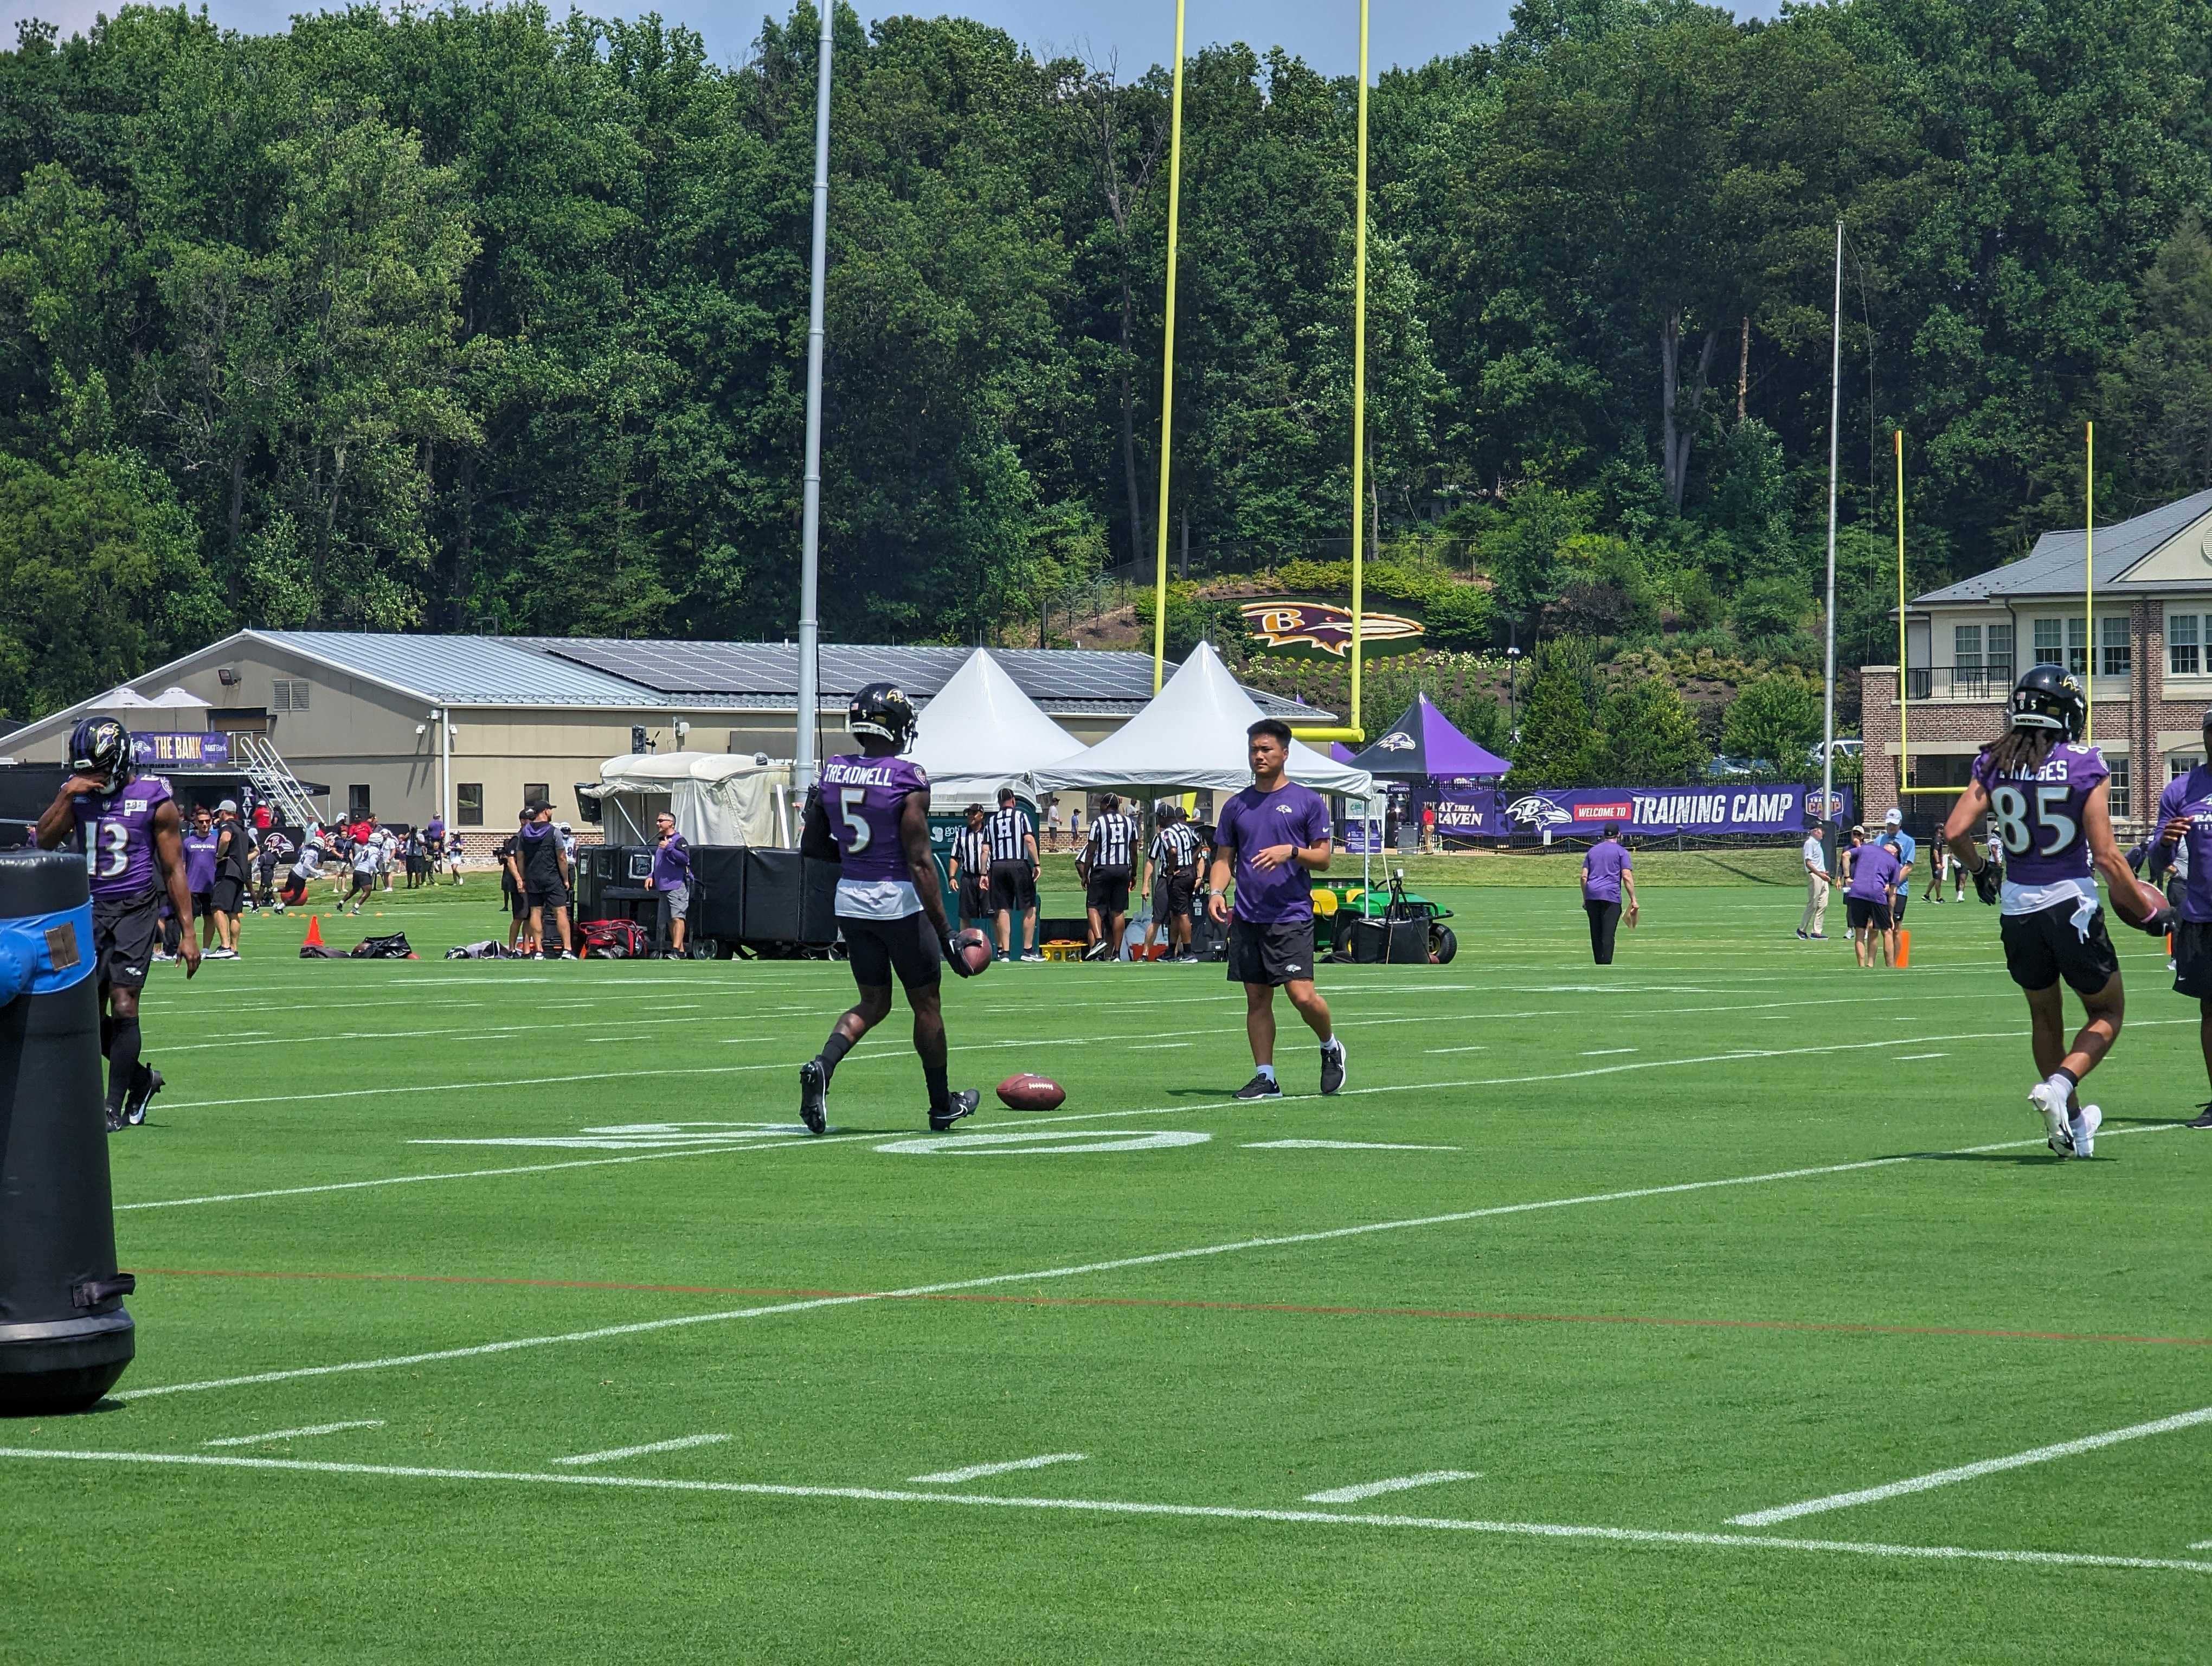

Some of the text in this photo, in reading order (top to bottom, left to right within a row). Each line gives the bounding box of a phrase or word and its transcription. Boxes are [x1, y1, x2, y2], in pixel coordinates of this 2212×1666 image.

[861, 709, 867, 719] 5
[154, 736, 202, 759] THE BANK
[824, 764, 892, 786] TREADWELL
[1578, 793, 1793, 824] WELCOME TO TRAINING CAMP
[1808, 803, 1841, 812] CAP
[840, 787, 871, 854] 5
[996, 817, 1012, 838] H
[1989, 785, 2078, 857] 85
[1110, 823, 1125, 843] H
[1179, 830, 1191, 850] B
[85, 820, 130, 877] 13
